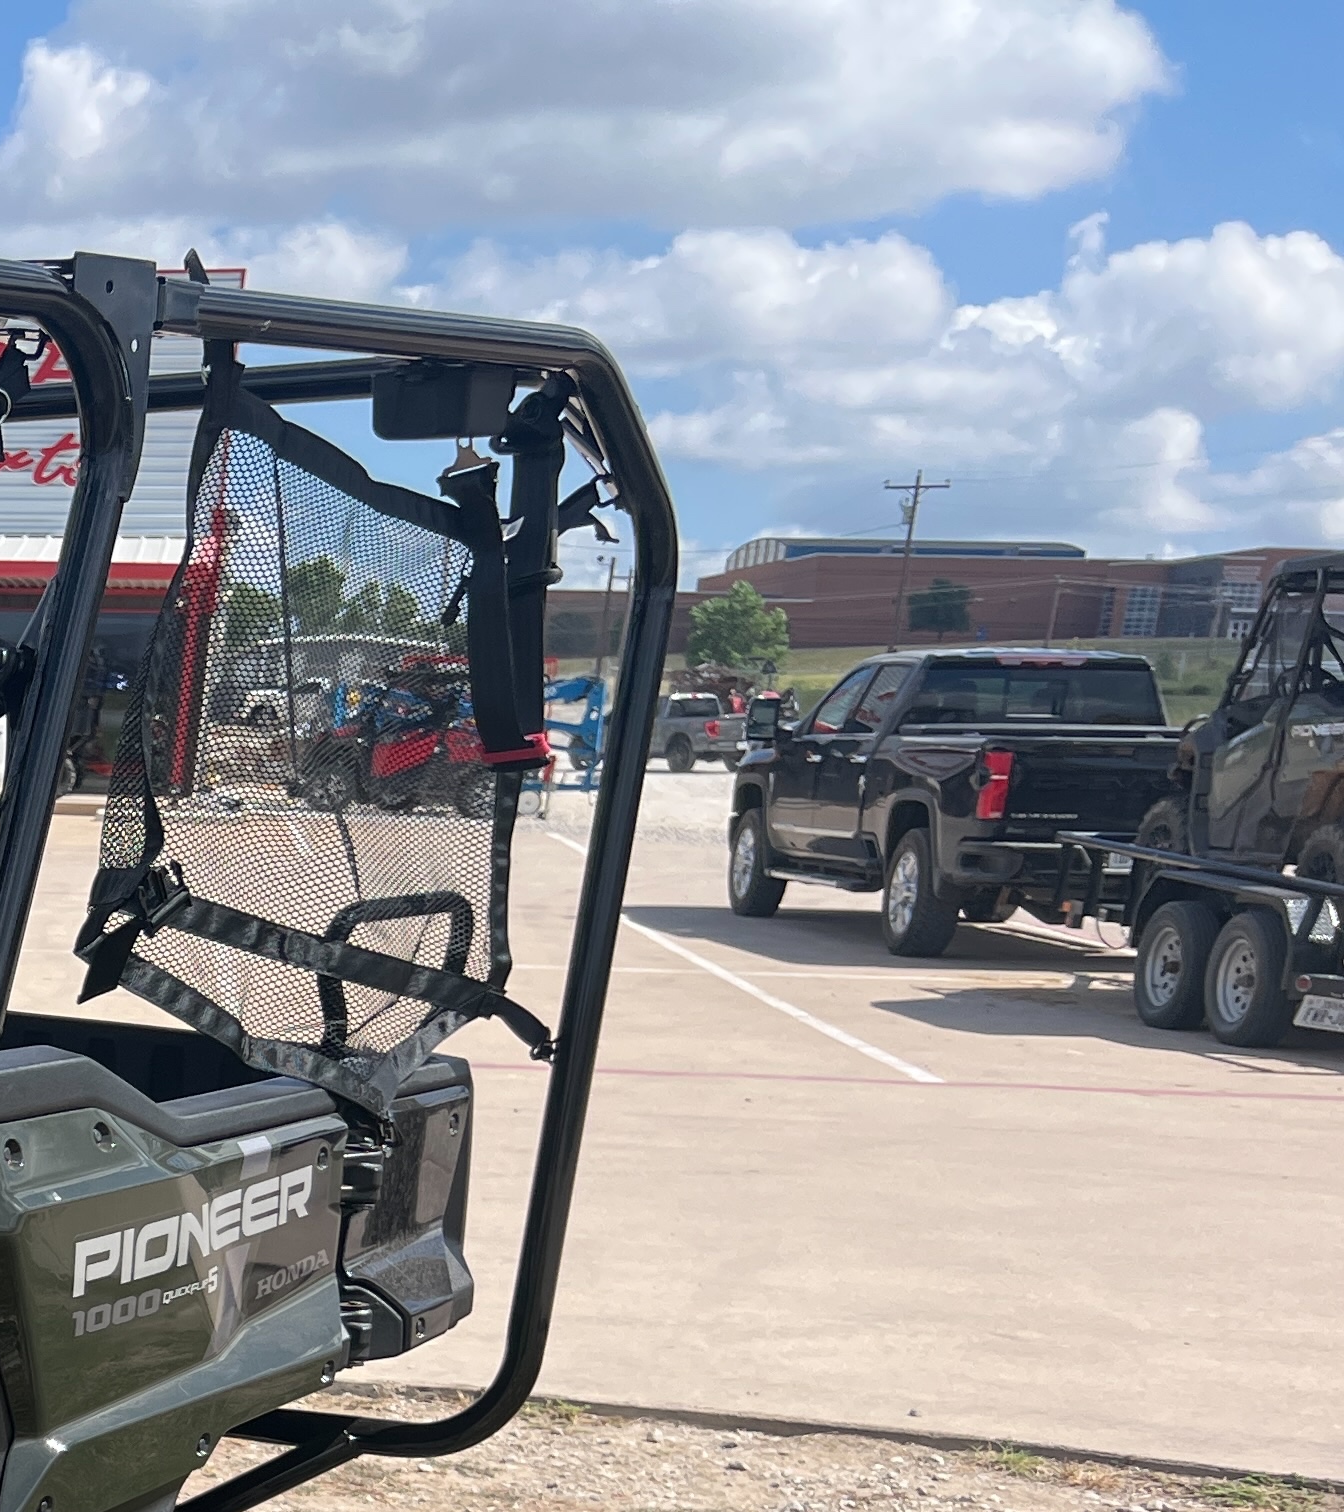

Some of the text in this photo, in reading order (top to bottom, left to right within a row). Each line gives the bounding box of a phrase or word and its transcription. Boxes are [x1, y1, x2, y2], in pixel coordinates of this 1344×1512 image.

[72, 1164, 313, 1298] PIONEER
[255, 1249, 330, 1300] HONDA
[72, 1288, 162, 1338] 1000
